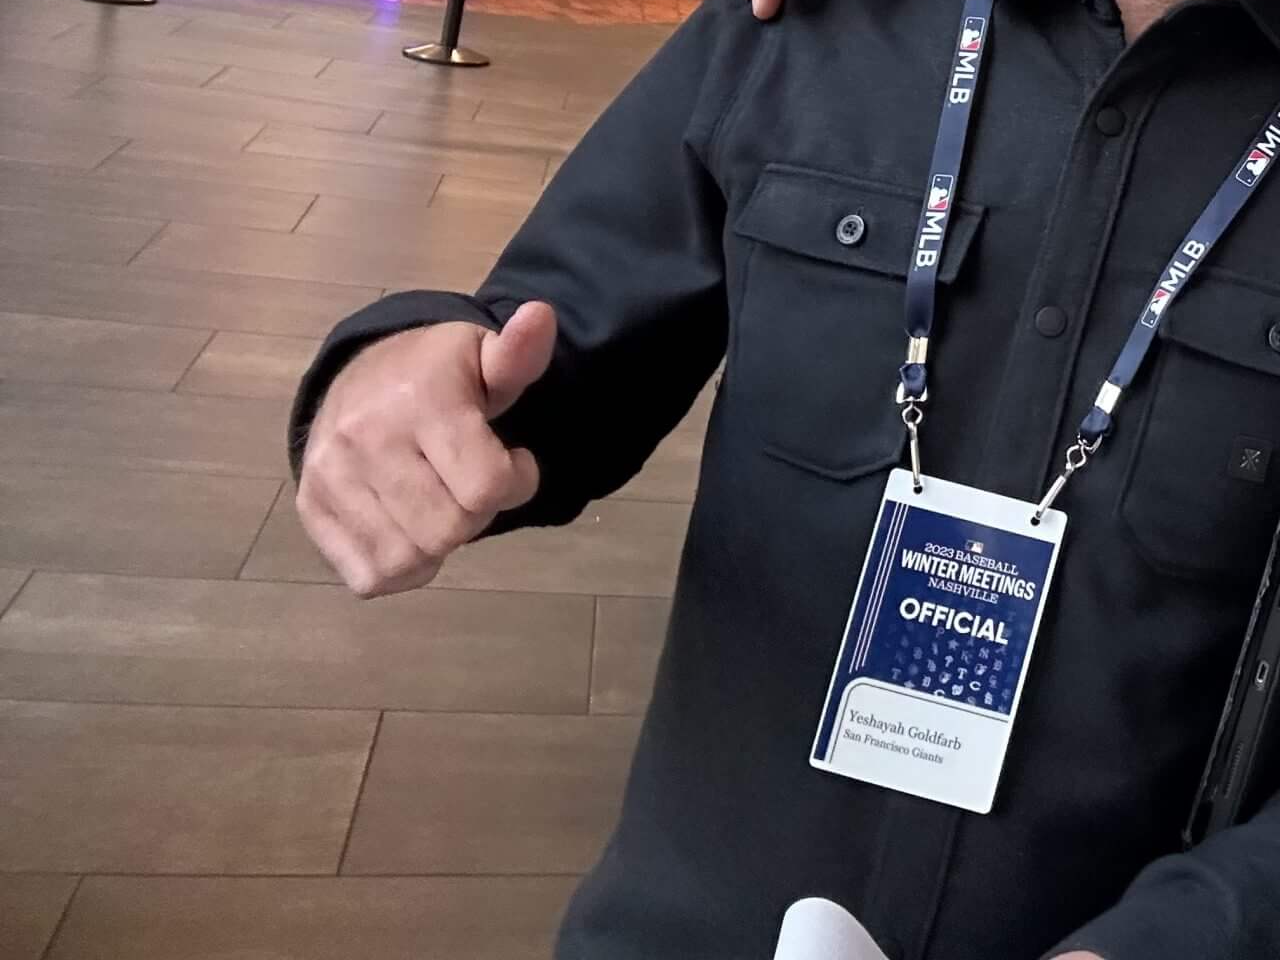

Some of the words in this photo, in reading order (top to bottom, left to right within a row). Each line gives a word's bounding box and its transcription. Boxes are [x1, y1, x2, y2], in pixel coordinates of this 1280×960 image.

[949, 52, 978, 104] MLB
[916, 212, 946, 267] MLB
[1160, 240, 1206, 293] MLB
[901, 548, 959, 581] WINTER
[958, 563, 1036, 601] MEETINGS
[923, 541, 954, 559] 2023
[955, 549, 1019, 576] BASEBALL
[927, 576, 999, 605] NASHVILLE
[899, 597, 1009, 645] OFFICIAL
[842, 728, 862, 742] San
[864, 734, 910, 756] Francisco
[911, 747, 944, 764] Giants
[849, 709, 905, 735] Yeshayah
[908, 726, 962, 750] Goldfarb
